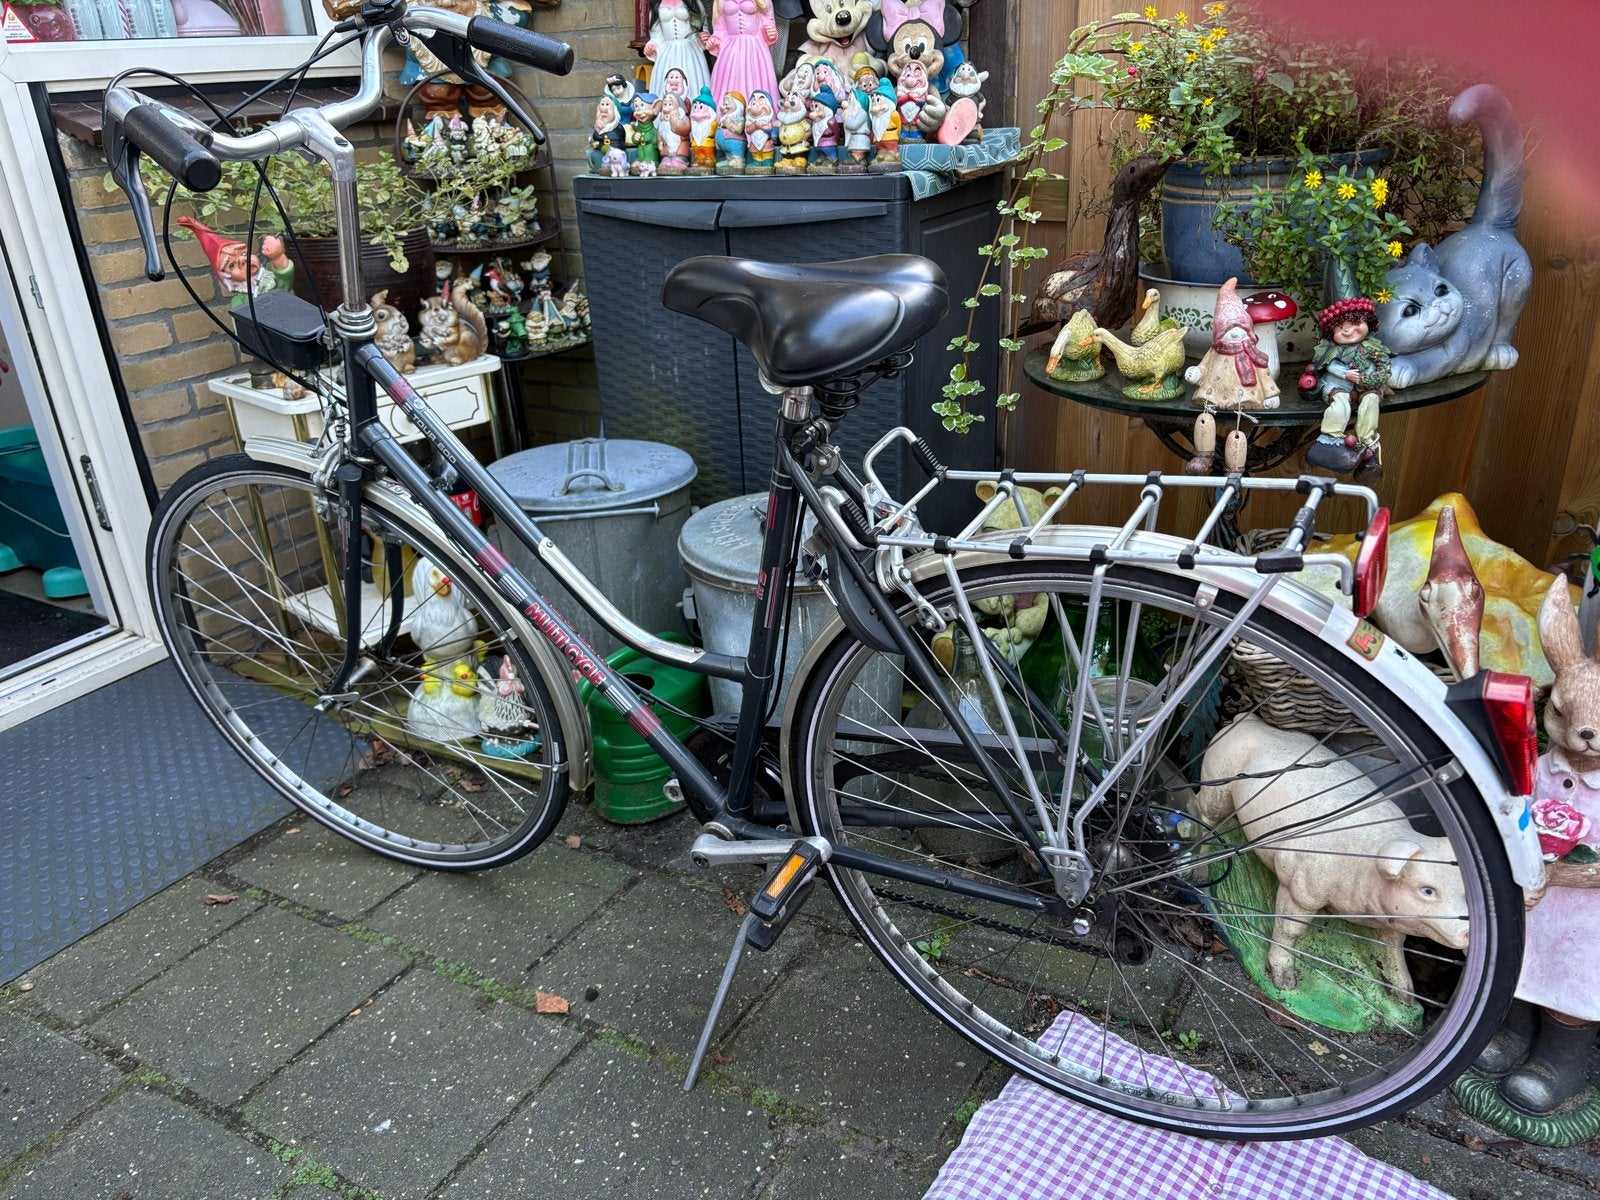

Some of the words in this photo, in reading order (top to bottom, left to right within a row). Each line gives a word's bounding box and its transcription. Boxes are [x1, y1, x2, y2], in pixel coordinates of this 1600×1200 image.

[412, 413, 437, 442] TOUR
[437, 442, 457, 464] 600
[524, 602, 571, 649] MULTI
[564, 643, 607, 688] CYCLE
